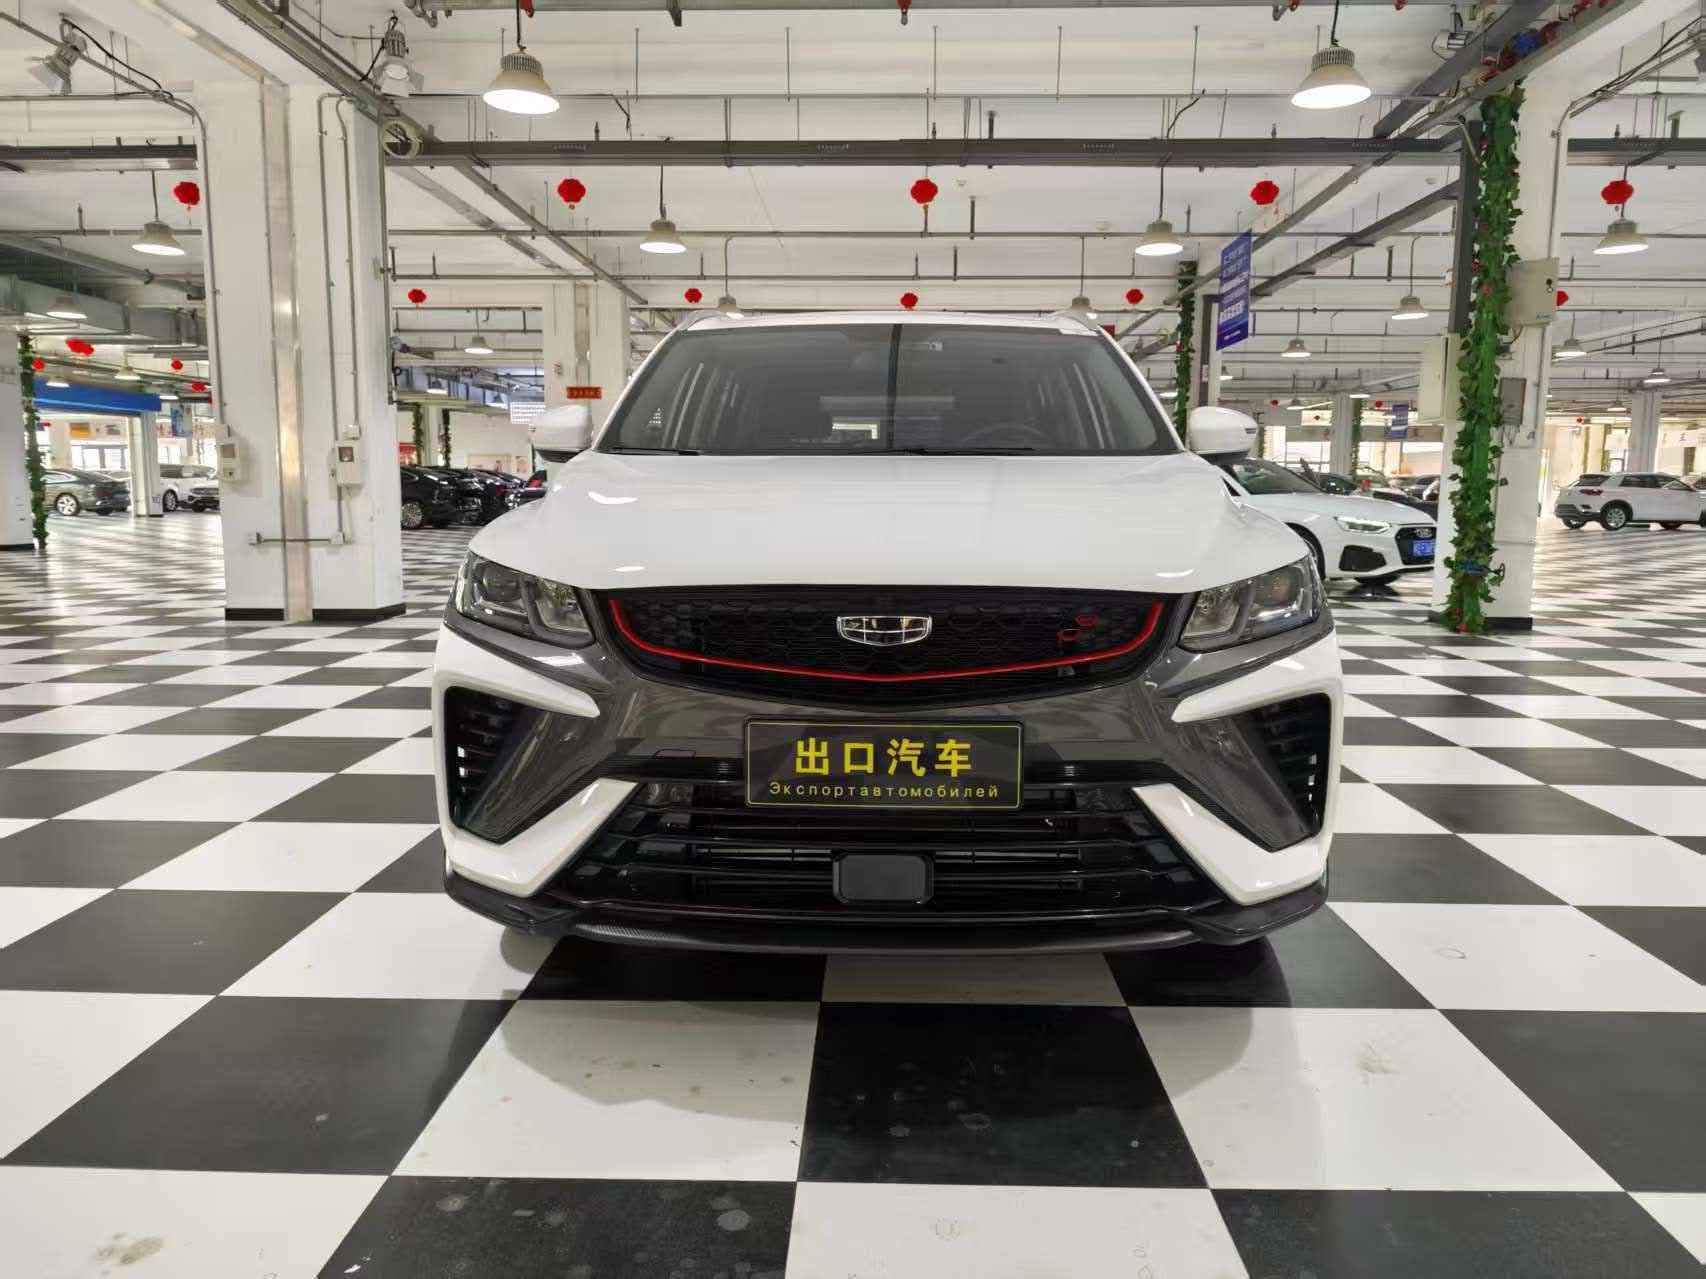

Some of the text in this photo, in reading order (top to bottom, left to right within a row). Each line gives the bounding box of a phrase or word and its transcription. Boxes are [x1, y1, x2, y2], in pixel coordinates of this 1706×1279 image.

[795, 737, 972, 777] 出口汽车
[769, 781, 999, 799] Экспортавтомобилей
